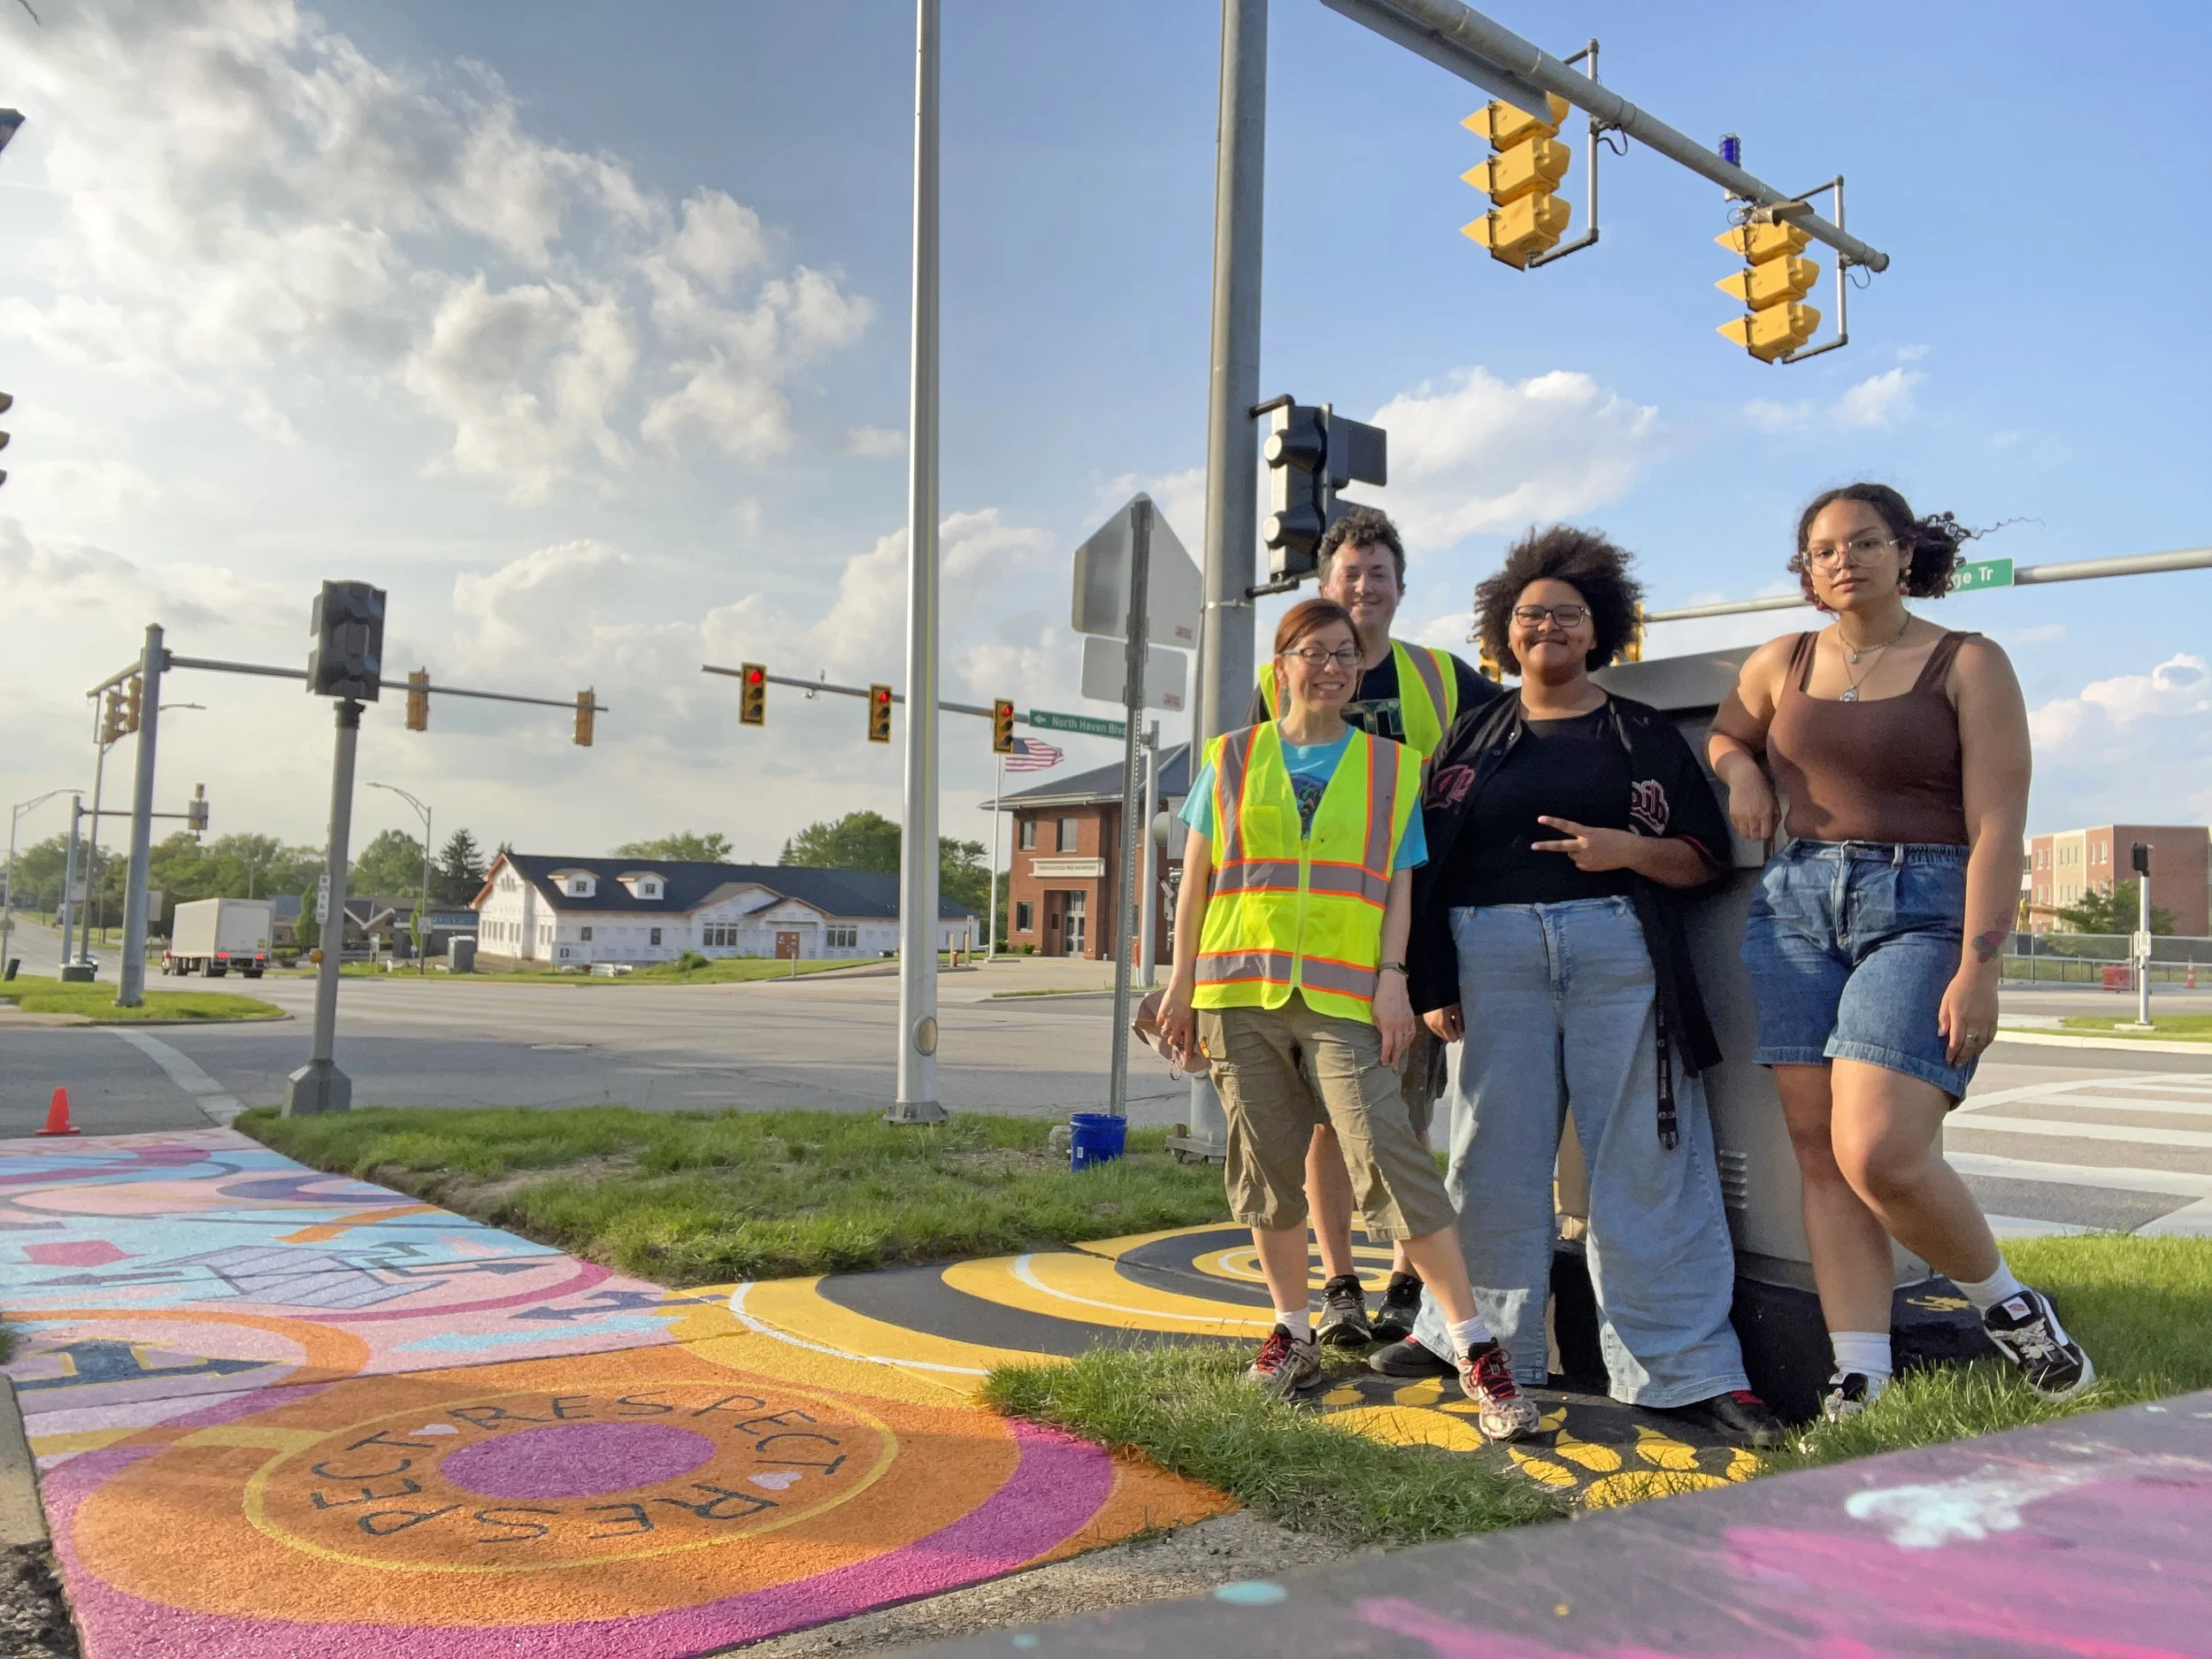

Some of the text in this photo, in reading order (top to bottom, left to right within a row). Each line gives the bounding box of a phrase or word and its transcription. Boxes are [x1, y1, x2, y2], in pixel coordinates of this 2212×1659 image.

[1950, 566, 1993, 590] ge Tr
[1052, 715, 1078, 729] North
[1079, 719, 1107, 733] Haven
[446, 1390, 848, 1476] RESPECT
[310, 1430, 780, 1543] RESPECT
